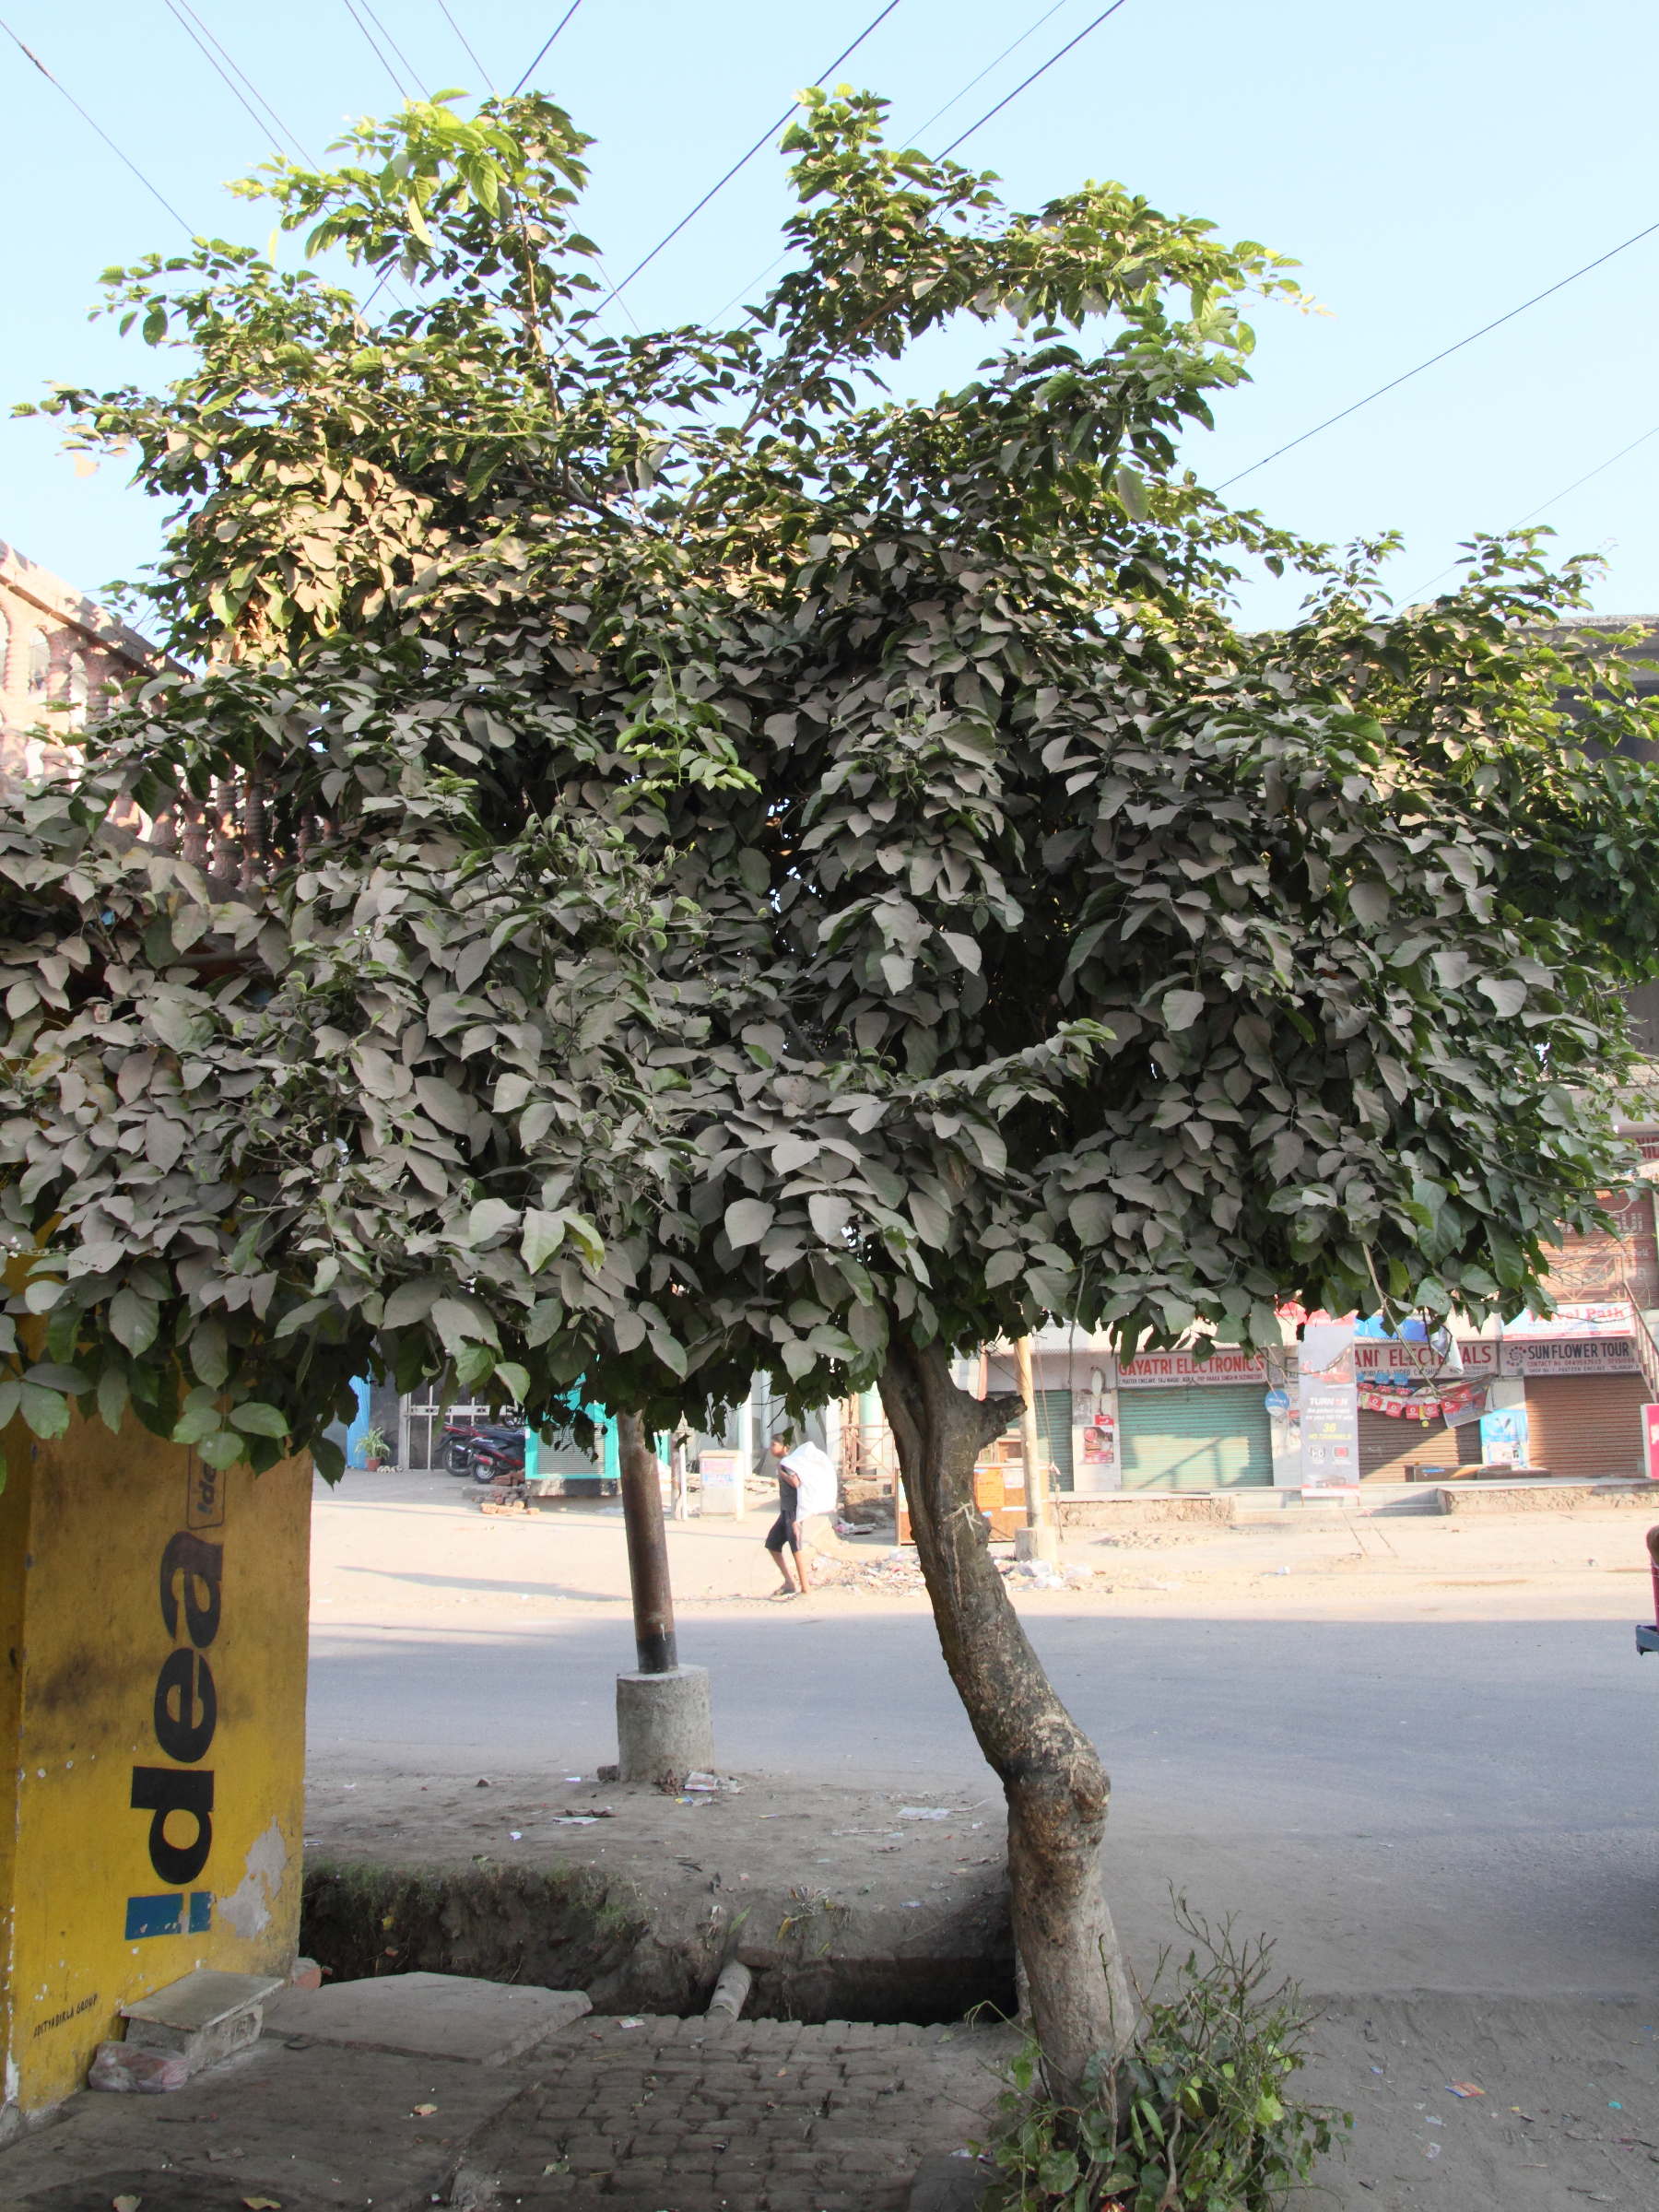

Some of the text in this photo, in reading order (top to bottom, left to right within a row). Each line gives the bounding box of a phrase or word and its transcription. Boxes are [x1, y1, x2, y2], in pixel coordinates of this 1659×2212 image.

[1600, 1341, 1630, 1358] TOUR
[1118, 1354, 1265, 1376] GAYATRI ELECTRONICS
